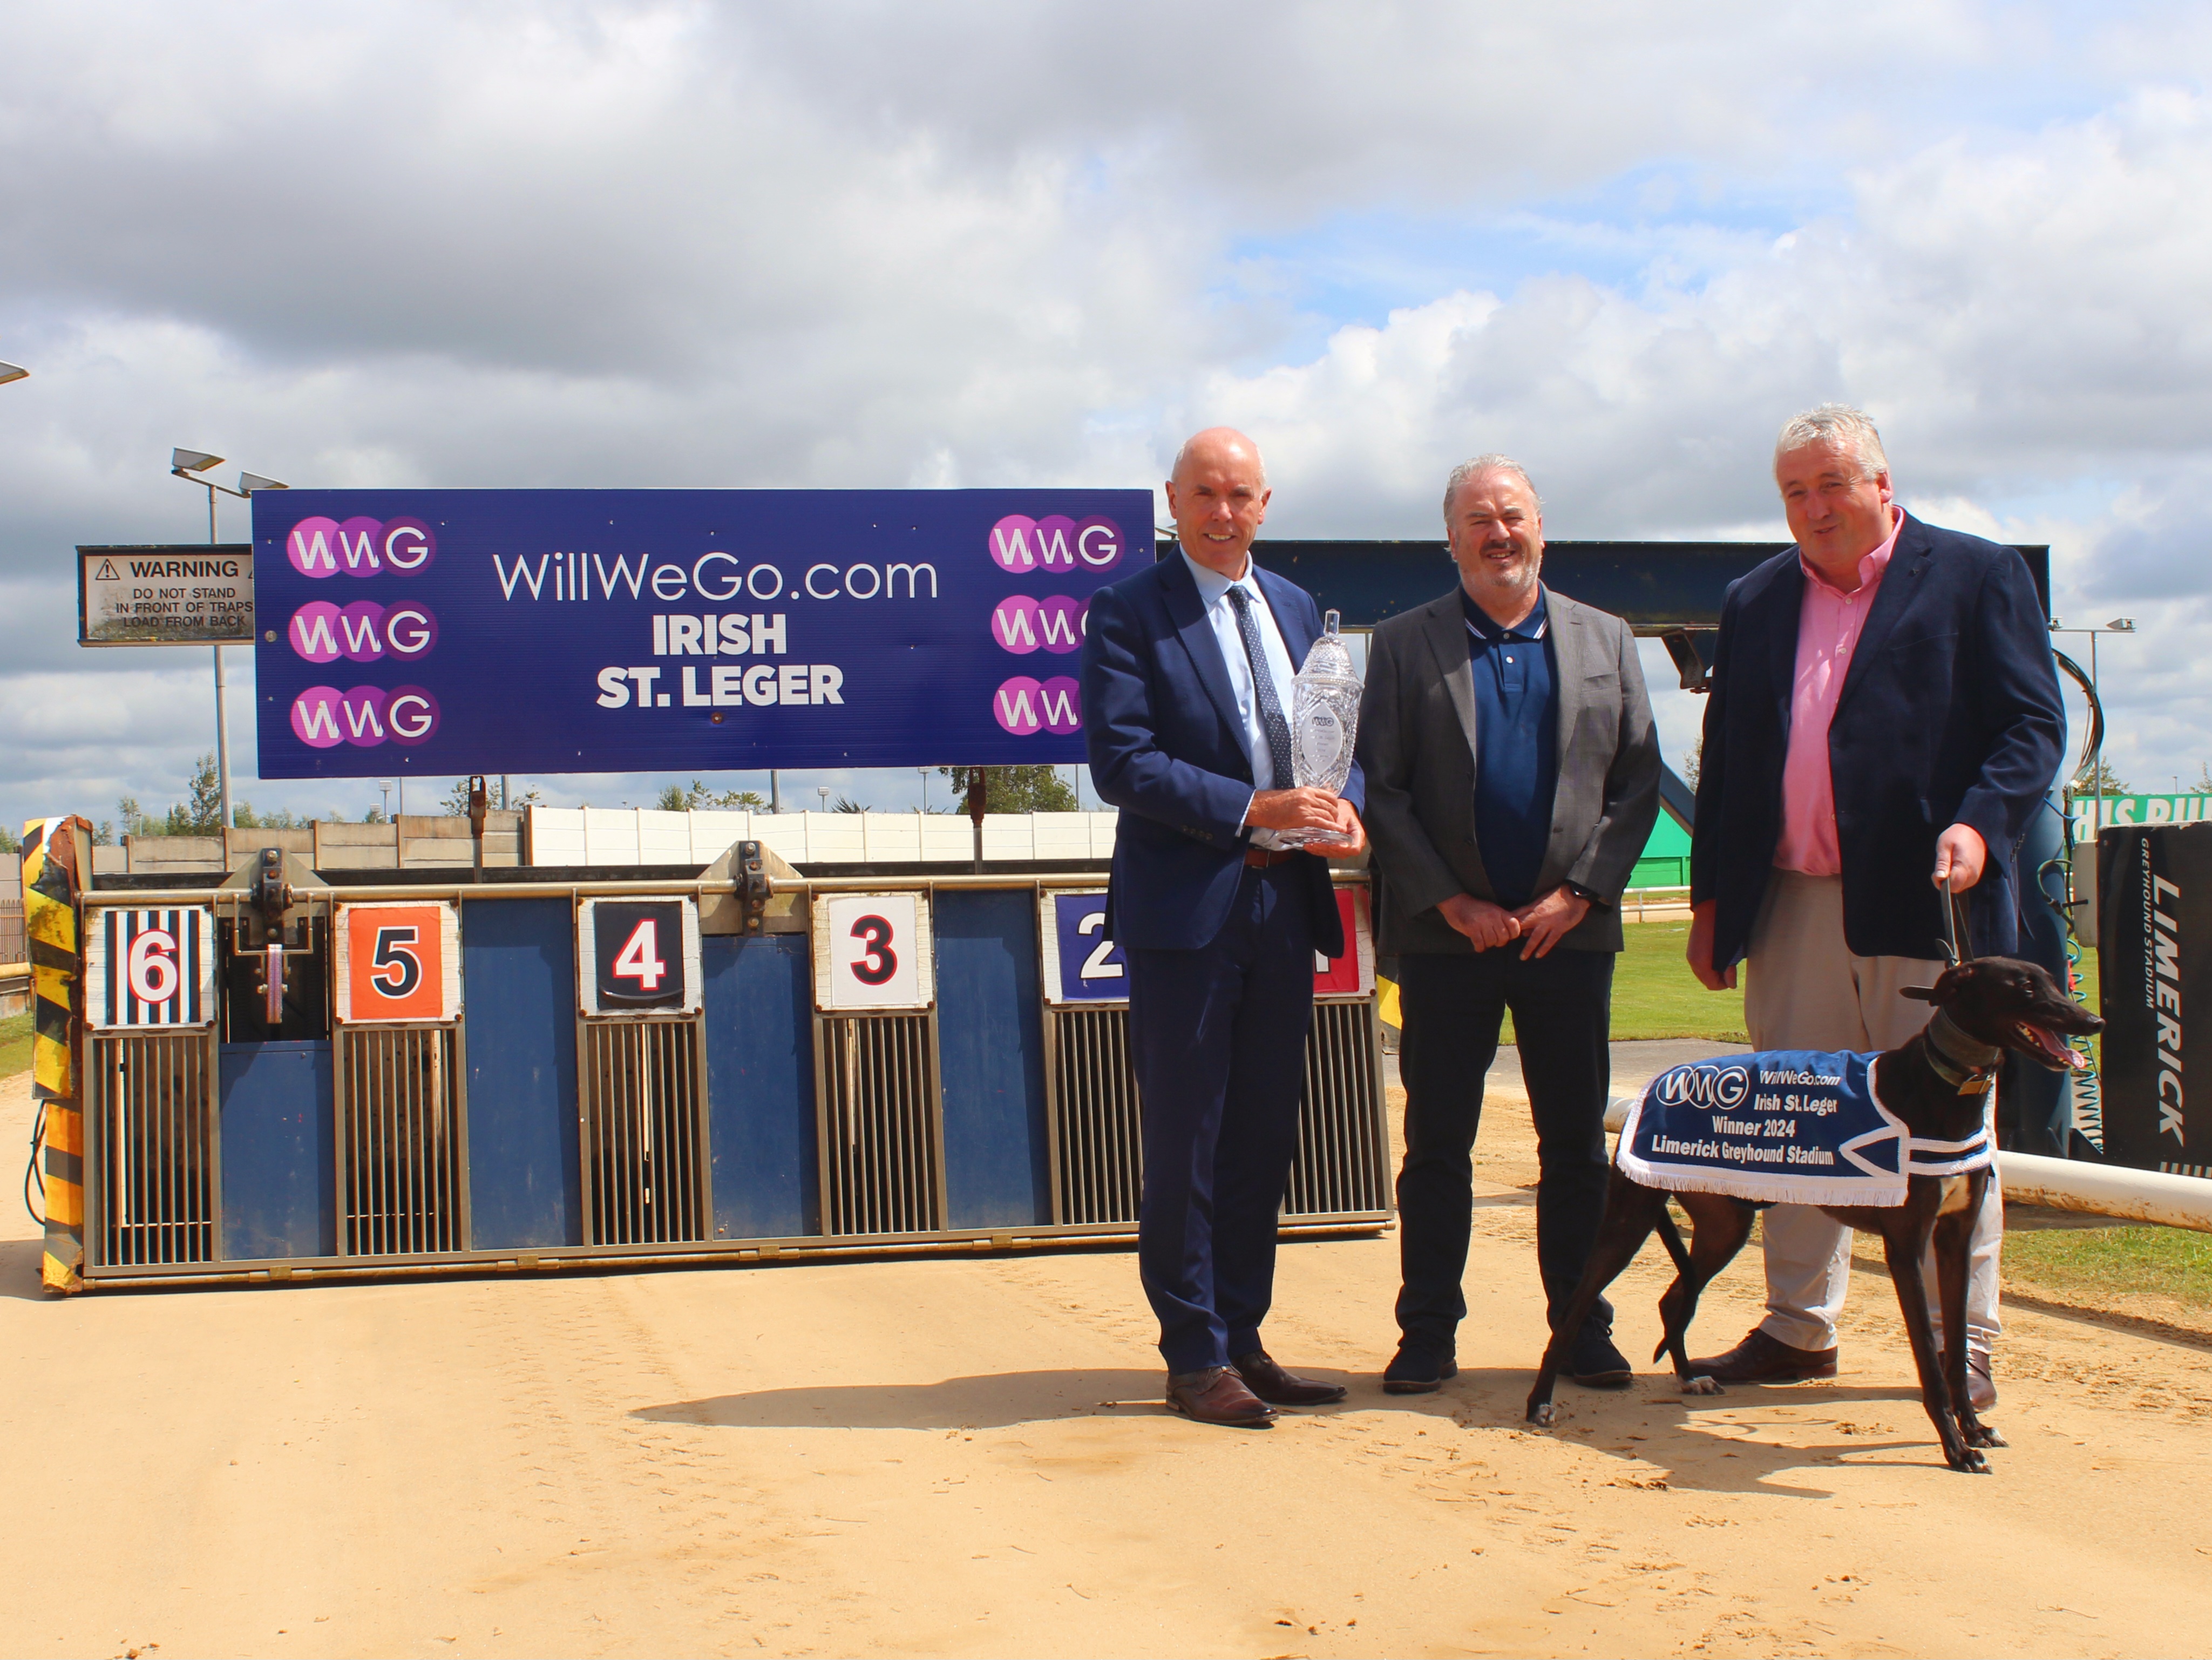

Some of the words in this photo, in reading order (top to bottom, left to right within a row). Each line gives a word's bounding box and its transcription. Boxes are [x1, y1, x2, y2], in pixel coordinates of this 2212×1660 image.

[293, 526, 428, 570] WWG
[994, 525, 1117, 565] WWG
[130, 560, 239, 577] WARNING
[493, 552, 937, 601] WillWeGo.com
[116, 603, 129, 613] IN
[135, 602, 180, 613] FRONT
[186, 602, 203, 612] OF
[209, 602, 253, 612] TRAPS
[134, 588, 153, 599] DO
[160, 588, 187, 599] NOT
[193, 588, 235, 598] STAND
[124, 617, 159, 627] LOAD
[166, 616, 203, 627] FROM
[210, 616, 246, 626] BACK
[295, 611, 430, 654] WWG
[653, 614, 786, 655] IRISH
[996, 609, 1087, 646] WW
[597, 667, 670, 708] ST.
[682, 665, 845, 707] LEGER
[297, 695, 432, 739] WWG
[2141, 838, 2152, 933] GREYHOUND
[128, 929, 179, 1004] 6
[370, 926, 423, 999] 5
[613, 919, 666, 991] 4
[850, 914, 898, 985] 3
[1078, 911, 1123, 979] 2
[2144, 937, 2154, 1009] STADIUM
[2153, 874, 2184, 1147] LIMERICK
[1665, 1070, 1744, 1105] WWG
[1760, 1070, 1841, 1086] WillWeGo.com
[1754, 1094, 1780, 1111] Irish
[1712, 1115, 1761, 1136] Winner
[1764, 1119, 1796, 1137] 2024
[1652, 1135, 1719, 1158] Limerick
[1722, 1141, 1784, 1163] Greyhound
[1787, 1145, 1834, 1165] Stadium
